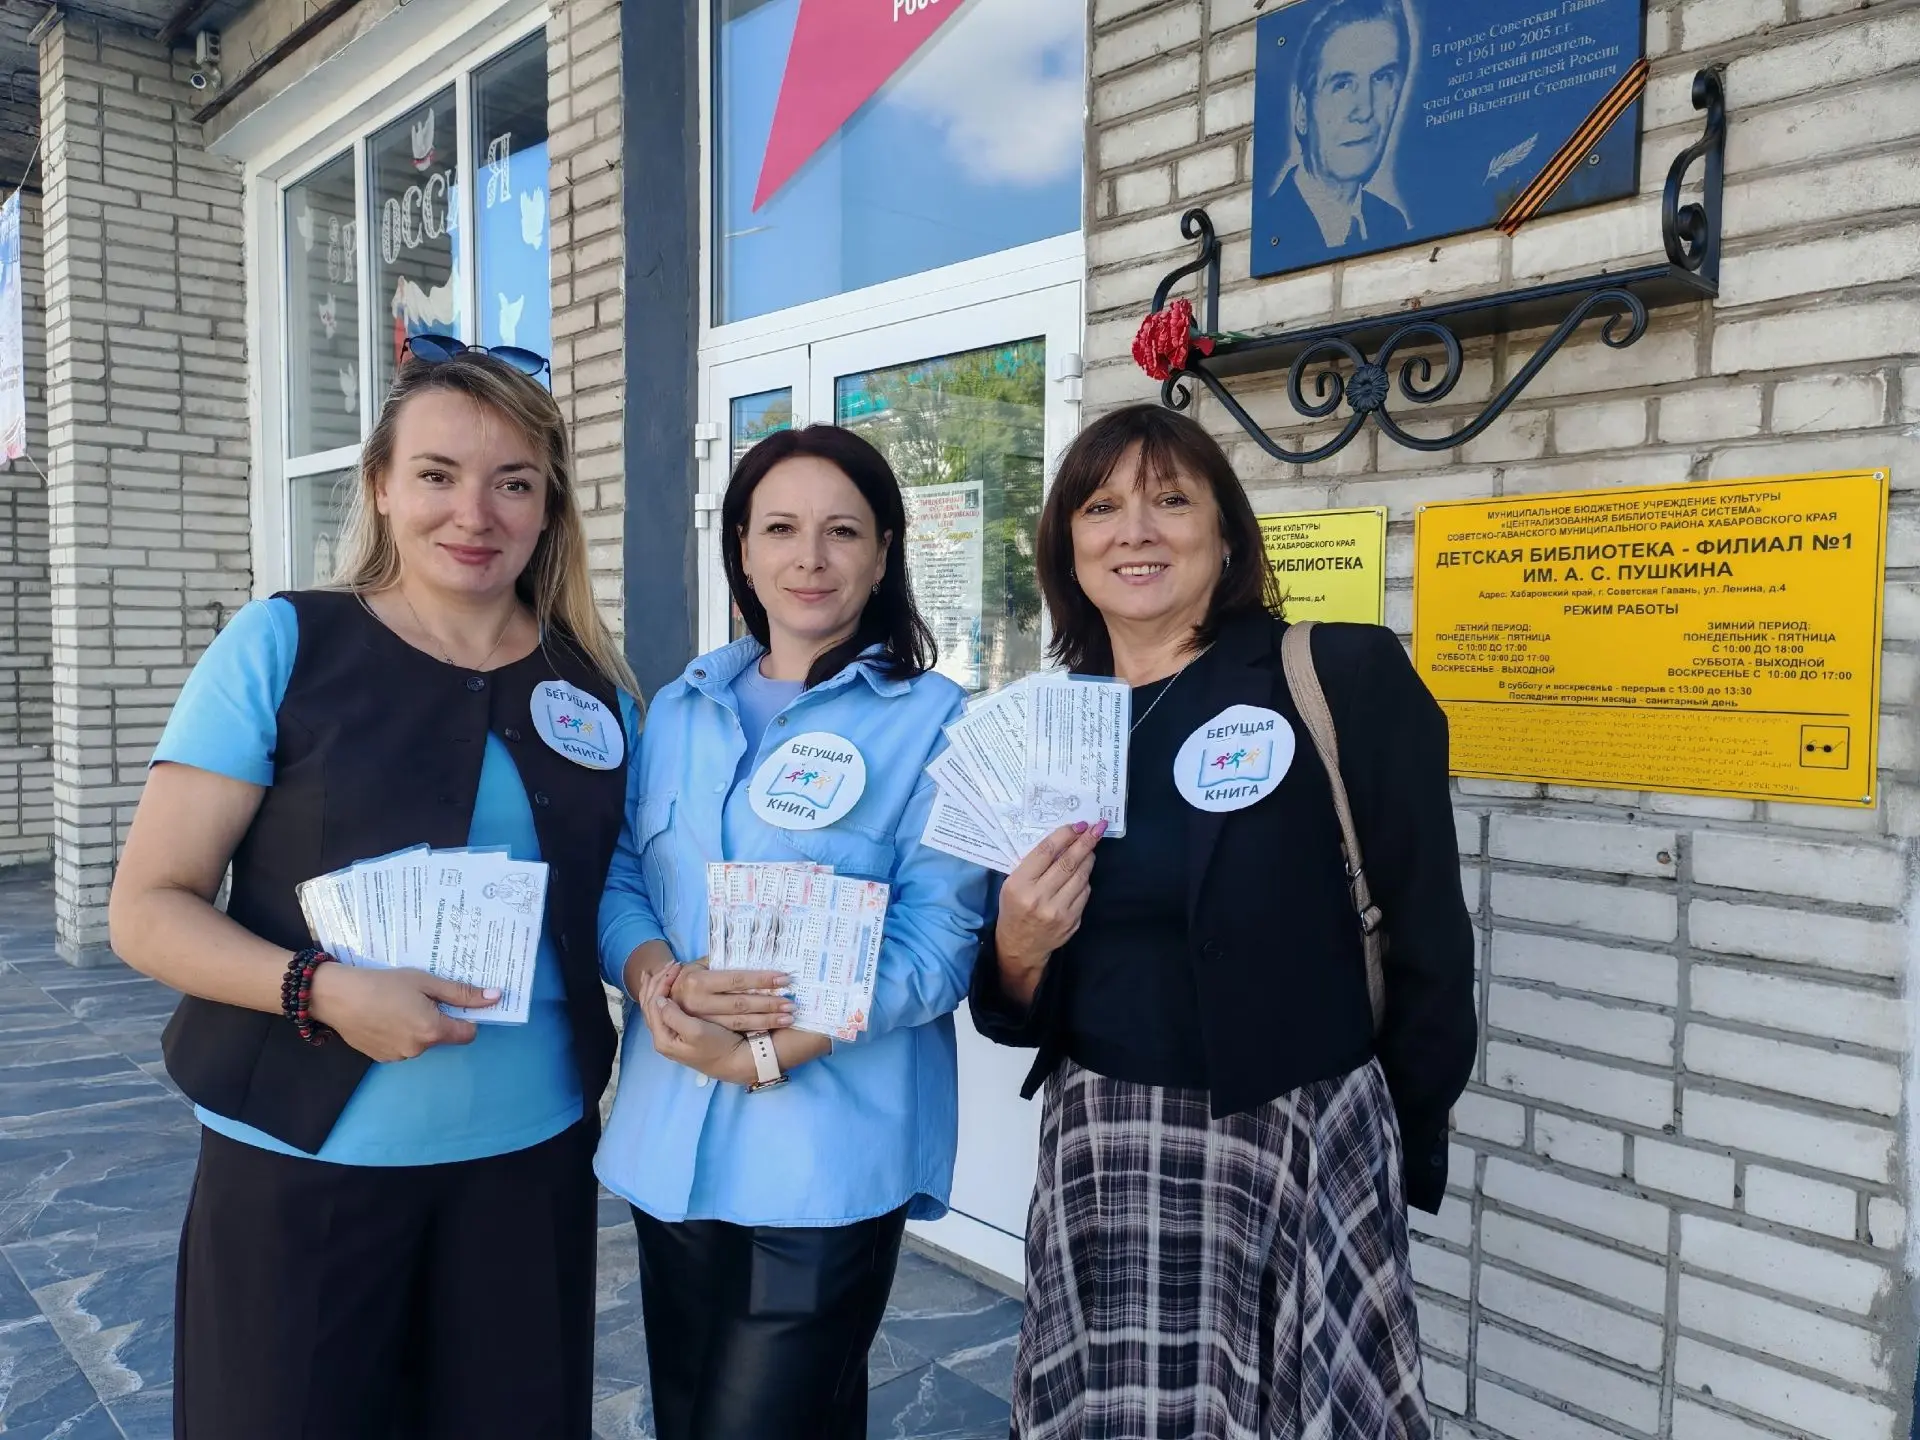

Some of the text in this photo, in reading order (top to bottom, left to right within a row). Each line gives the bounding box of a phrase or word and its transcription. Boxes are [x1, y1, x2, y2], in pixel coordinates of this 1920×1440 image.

[1432, 44, 1440, 57] В
[1444, 33, 1485, 54] городе
[1489, 9, 1557, 39] Советская
[1456, 57, 1463, 66] с
[1468, 45, 1494, 63] 1961
[1520, 27, 1551, 46] 2005
[1448, 35, 1596, 86] жил детский писатель,
[1423, 45, 1620, 111] член Союза писателей России
[1426, 65, 1617, 127] Рыбин Валентин Степанович
[1487, 492, 1781, 519] МУНИЦИПАЛЬНОЕ БЮДЖЕТНОЕ УЧРЕЖДЕНИЕ КУЛЬТУРЫ
[1501, 505, 1762, 529] «ЦЕНТРАЛИЗОВАННАЯ БИБЛИОТЕЧНАЯ СИСТЕМА»
[1283, 523, 1321, 532] КУЛЬТУРЫ
[1448, 512, 1837, 541] СОВЕТСКО-ГАВАНСКОГО МУНИЦИПАЛЬНОГО РАЙОНА ХАБАРОВСКОГО КРАЯ
[1272, 533, 1309, 541] СИСТЕМА»
[1277, 541, 1335, 550] ХАБАРОВСКОГО
[1336, 539, 1355, 547] КРАЯ
[1437, 549, 1523, 568] ДЕТСКАЯ
[1530, 542, 1675, 562] БИБЛИОТЕКА
[1696, 536, 1802, 554] ФИЛИАЛ
[1812, 533, 1852, 550] №1
[1524, 562, 1733, 582] ИМ. А. С. ПУШКИНА
[1510, 589, 1568, 599] Хабаровский
[1607, 586, 1658, 596] Советская
[1661, 586, 1700, 596] Гавань,
[1704, 587, 1719, 596] ул.
[1723, 585, 1765, 594] Ленина,
[1769, 583, 1786, 594] д.4
[1564, 604, 1679, 615] РЕЖИМ РАБОТЫ
[1454, 623, 1531, 632] ЛЕТНИЙ ПЕРИОД:
[1707, 621, 1811, 631] ЗИМНИЙ ПЕРИОД:
[1436, 634, 1499, 642] ПОНЕДЕЛЬНИК
[1508, 634, 1551, 642] ПЯТНИЦА
[1683, 633, 1768, 642] ПОНЕДЕЛЬНИК
[1779, 633, 1836, 643] ПЯТНИЦА
[1489, 644, 1502, 652] ДО
[1712, 645, 1804, 654] С 10:00 ДО 18:00
[1437, 653, 1476, 661] СУББОТА
[1510, 654, 1524, 663] ДО
[1527, 654, 1549, 662] 17:00
[1692, 658, 1744, 667] СУББОТА
[1755, 658, 1825, 668] ВЫХОДНОЙ
[1431, 665, 1494, 673] ВОСКРЕСЕНЬЕ
[1502, 665, 1555, 674] ВЫХОДНОЙ
[1668, 668, 1852, 680] ВОСКРЕСЕНЬЕ С 10:00 ДО 17:00
[1499, 681, 1505, 689] В
[1507, 682, 1543, 691] субботу
[1554, 683, 1613, 692] воскресенье
[1621, 685, 1665, 694] перерыв
[1678, 686, 1704, 694] 13:00
[1707, 688, 1720, 696] до
[1725, 687, 1752, 696] 13:30
[545, 687, 599, 712] БЕГУЩАЯ
[1509, 692, 1558, 701] Последний
[1646, 697, 1708, 706] санитарный
[1712, 699, 1738, 708] день
[1207, 720, 1274, 739] БЕГУЩАЯ
[563, 743, 607, 763] КНИГА
[791, 743, 853, 764] БЕГУЩАЯ
[1205, 784, 1258, 800] КНИГА
[766, 798, 816, 820] КНИГА
